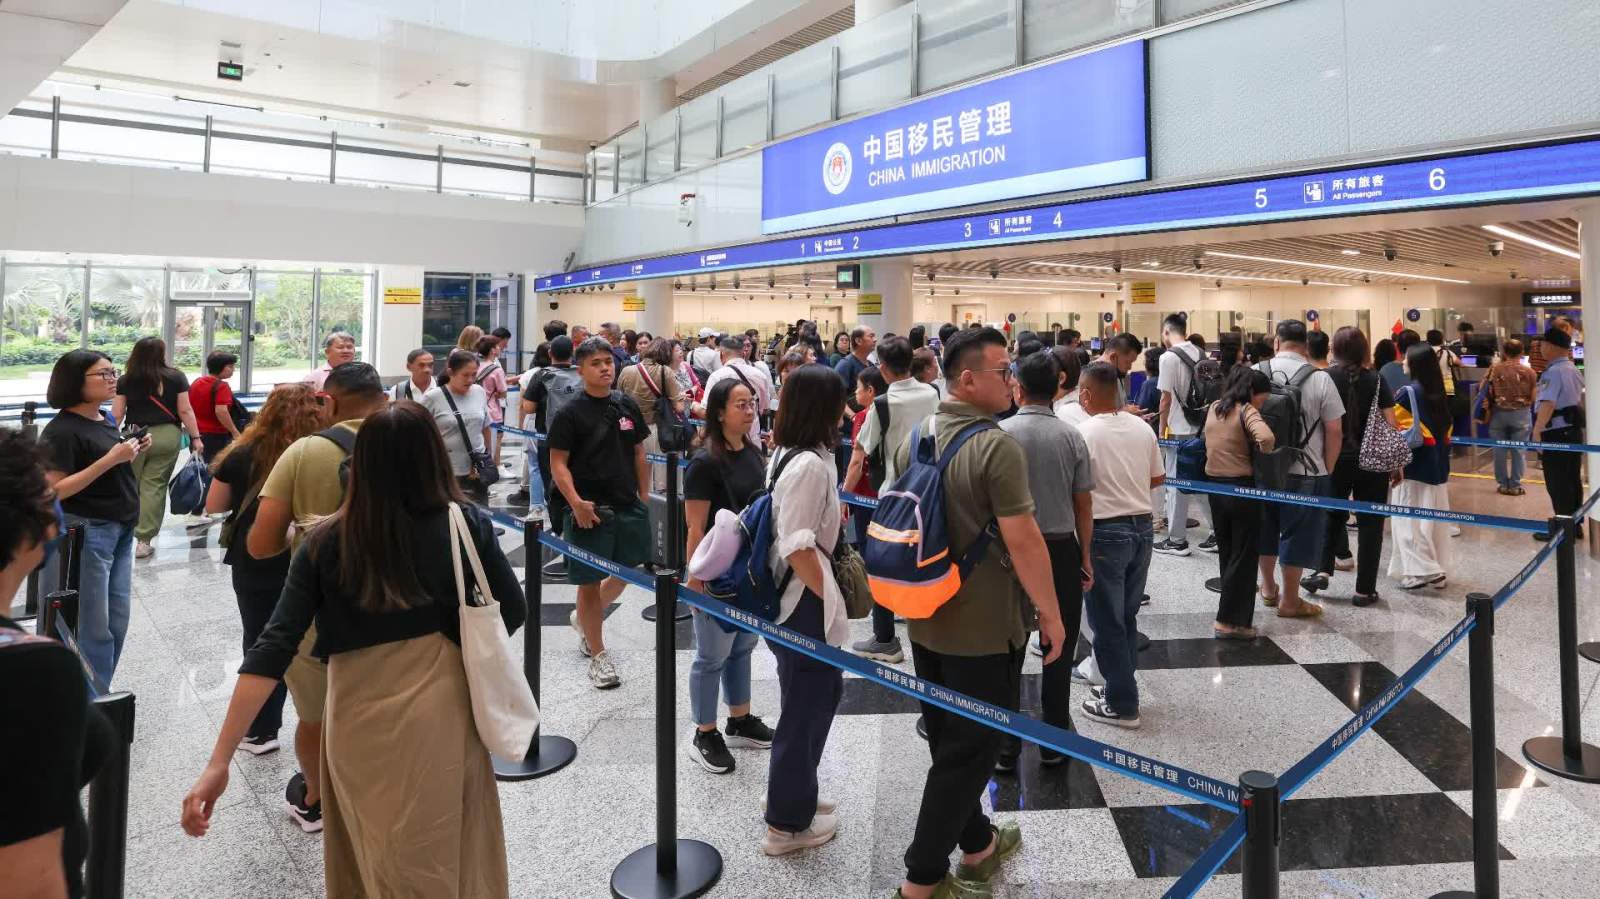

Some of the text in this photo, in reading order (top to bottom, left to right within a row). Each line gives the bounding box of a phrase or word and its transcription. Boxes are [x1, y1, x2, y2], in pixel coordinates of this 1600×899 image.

[863, 100, 1012, 165] 中国移民管理
[868, 144, 1005, 186] CHINA IMMIGRATION
[1332, 174, 1384, 191] 所有旅客
[1428, 167, 1446, 191] 6
[1255, 188, 1268, 208] 5
[1332, 190, 1382, 200] All Passengers
[964, 222, 972, 238] 3
[1053, 211, 1063, 229] 4
[800, 242, 805, 256] 1
[853, 236, 859, 250] 2
[876, 667, 925, 693] 中国移民管理
[930, 687, 1010, 724] CHINA IMMIGRATION
[1103, 749, 1179, 783] 中国移民管理
[1187, 776, 1225, 798] CHINA
